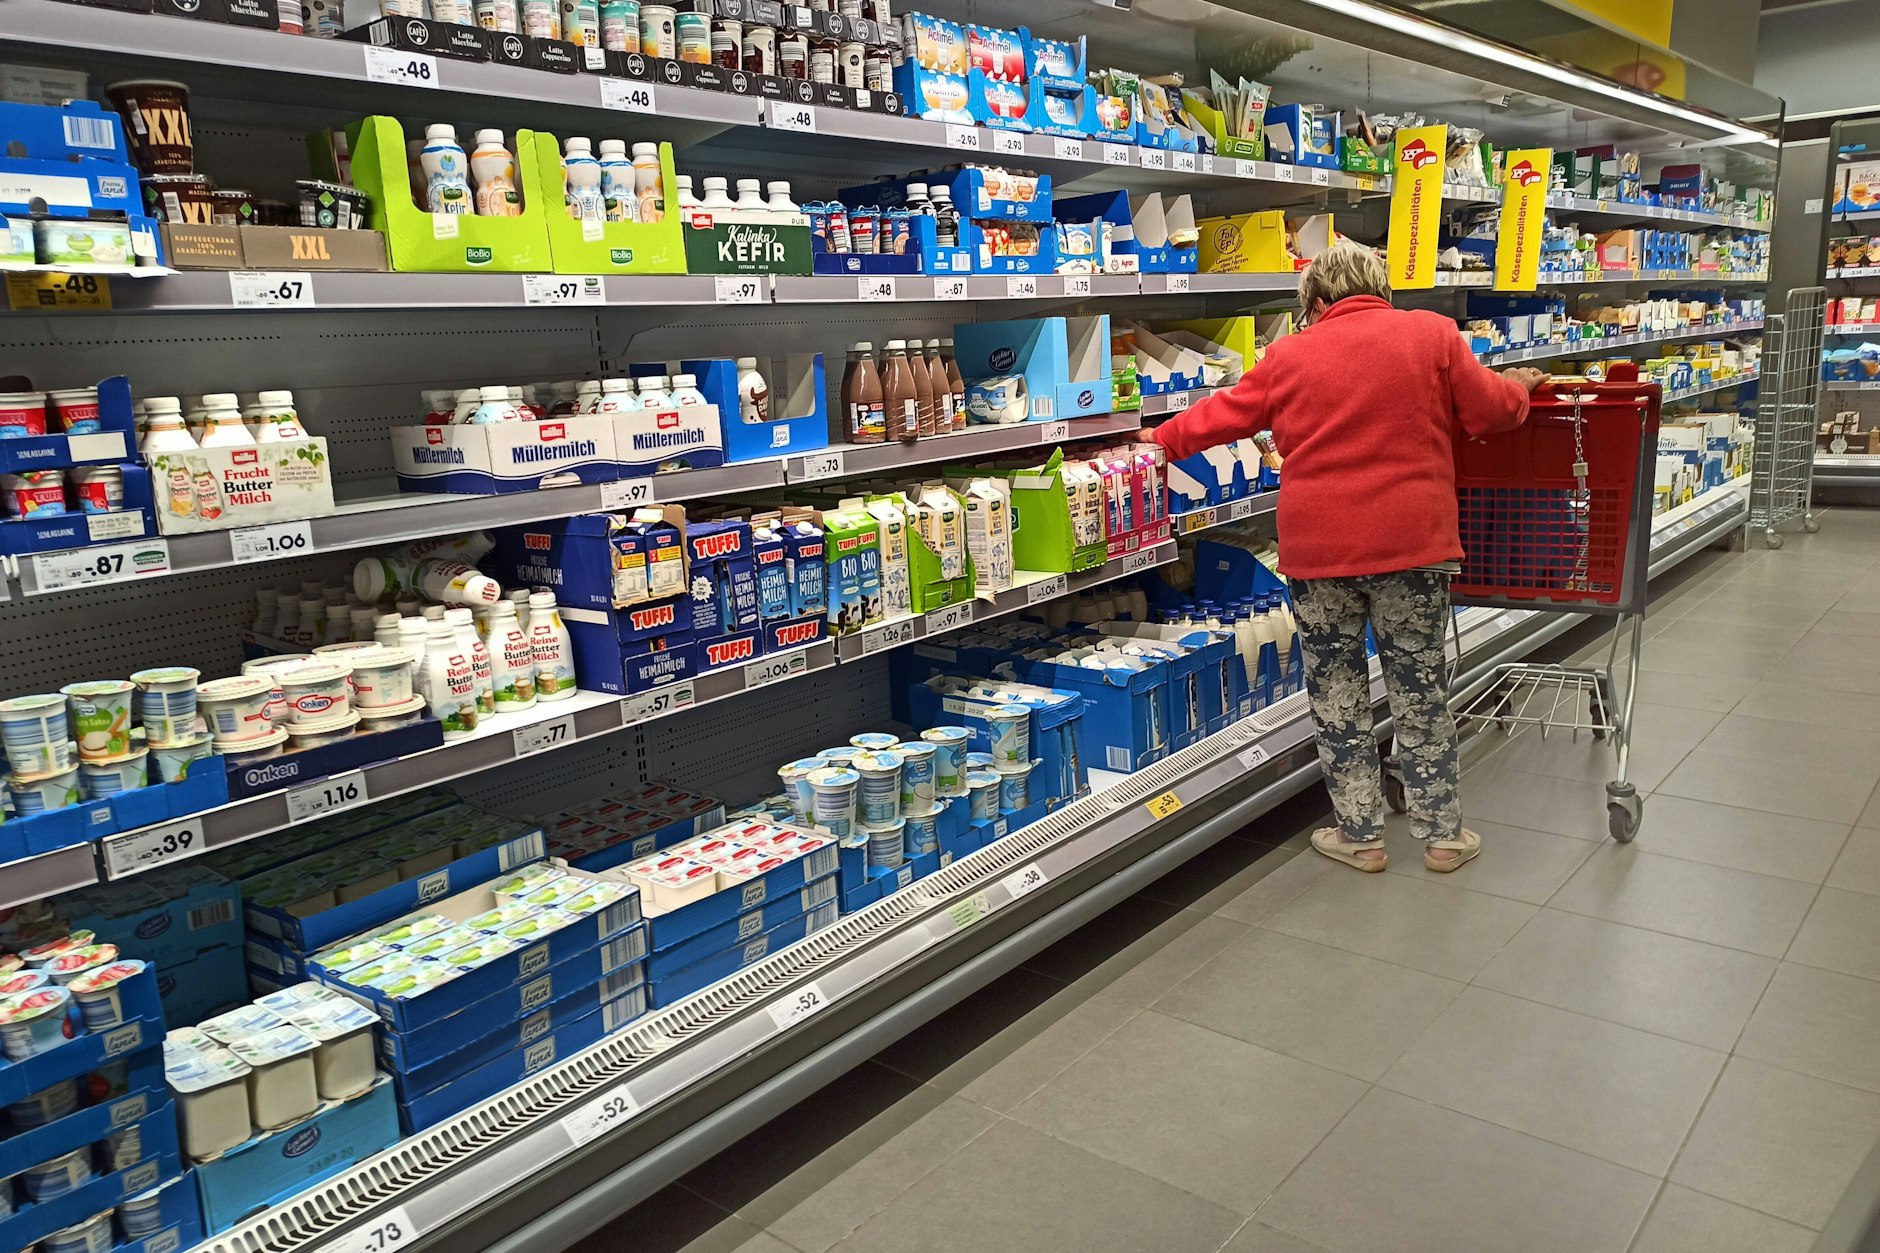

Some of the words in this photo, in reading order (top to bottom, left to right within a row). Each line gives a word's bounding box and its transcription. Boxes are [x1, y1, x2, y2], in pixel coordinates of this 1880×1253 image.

[927, 27, 955, 45] Actimel
[982, 36, 1011, 54] Actimel
[1039, 49, 1066, 64] Actimel
[398, 61, 431, 80] -.48
[625, 91, 650, 107] -.48
[727, 224, 777, 244] Kalinka
[1404, 178, 1423, 280] Käsespezialitäten
[290, 235, 331, 260] XXL
[1511, 194, 1528, 283] Käsespezialitäten
[468, 248, 491, 258] BioBio
[612, 249, 633, 261] BioBio
[717, 241, 786, 262] KEFIR
[53, 274, 98, 294] -.48
[269, 281, 302, 299] -.67
[553, 283, 578, 298] -.97
[736, 283, 756, 297] -.97
[873, 283, 892, 296] -.48
[632, 427, 705, 450] Müllermilch
[16, 448, 57, 460] SCHLAGSAHNE
[411, 446, 465, 465] Müllermilch
[511, 439, 596, 464] Müllermilch
[224, 467, 270, 481] Frucht
[822, 460, 839, 473] -.73
[222, 480, 274, 494] Butter
[625, 485, 647, 501] -.97
[229, 491, 272, 506] Milch
[266, 533, 306, 552] 1.06
[525, 534, 551, 550] TUFFI
[692, 533, 741, 559] TUFFI
[799, 544, 823, 557] TUFFI
[838, 538, 857, 550] TUFFI
[85, 554, 124, 576] -.87
[759, 551, 783, 564] TUFFI
[861, 551, 876, 572] BIO
[517, 565, 564, 586] HEIMATMILCH
[799, 566, 823, 582] HEIMAT
[841, 558, 857, 579] BIO
[735, 580, 755, 595] HEIMAT
[761, 572, 786, 588] HEIMAT
[799, 579, 824, 597] MILCH
[737, 592, 755, 609] MILCH
[762, 585, 787, 605] MILCH
[630, 606, 674, 631] TUFFI
[530, 636, 559, 646] Reine
[776, 621, 819, 645] TUFFI
[532, 652, 560, 661] Milch
[707, 637, 754, 665] TUFFI
[639, 657, 686, 680] HEIMATMILCH
[766, 664, 789, 679] 1.06
[300, 698, 329, 710] Onken
[648, 694, 670, 713] -.57
[543, 724, 567, 742] -.77
[245, 762, 299, 787] Onken
[323, 783, 359, 806] 1.16
[152, 830, 194, 856] -.39
[796, 992, 820, 1013] -.52
[598, 1096, 629, 1122] -.52
[364, 1221, 402, 1252] -.73
